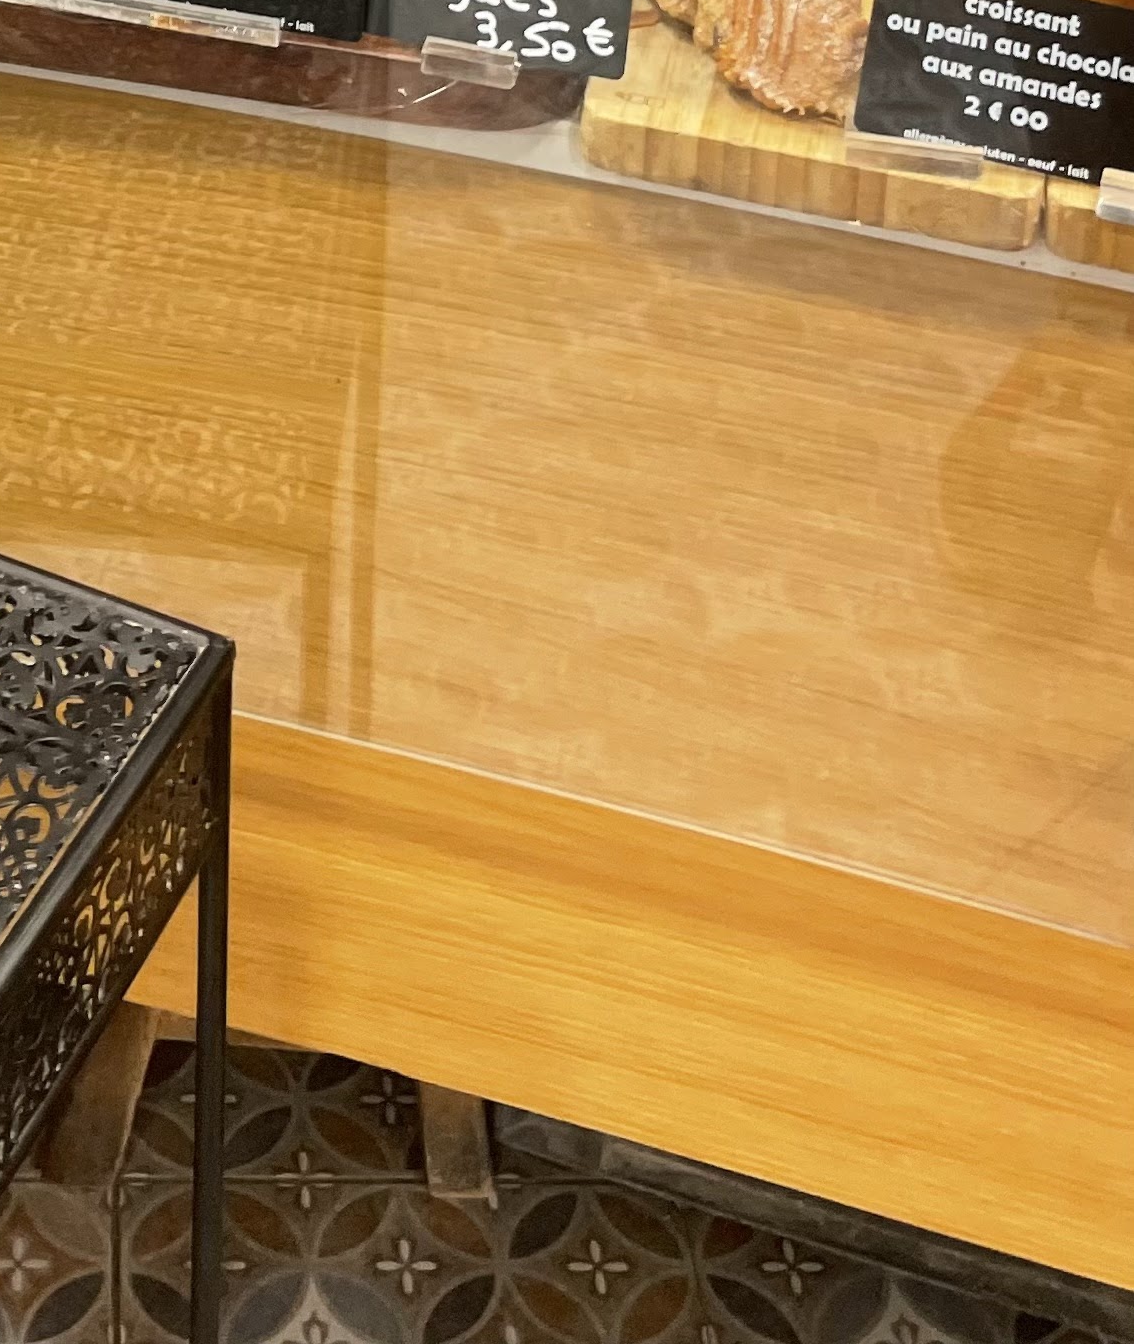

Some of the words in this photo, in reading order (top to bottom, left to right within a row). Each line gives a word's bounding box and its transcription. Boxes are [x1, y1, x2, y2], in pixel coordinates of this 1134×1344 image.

[887, 13, 920, 35] ou
[926, 21, 988, 51] pain
[994, 37, 1031, 60] au
[922, 55, 973, 81] aux
[979, 67, 1101, 110] amandes
[964, 95, 980, 117] 2
[988, 101, 1003, 122] €
[1010, 106, 1048, 131] 00
